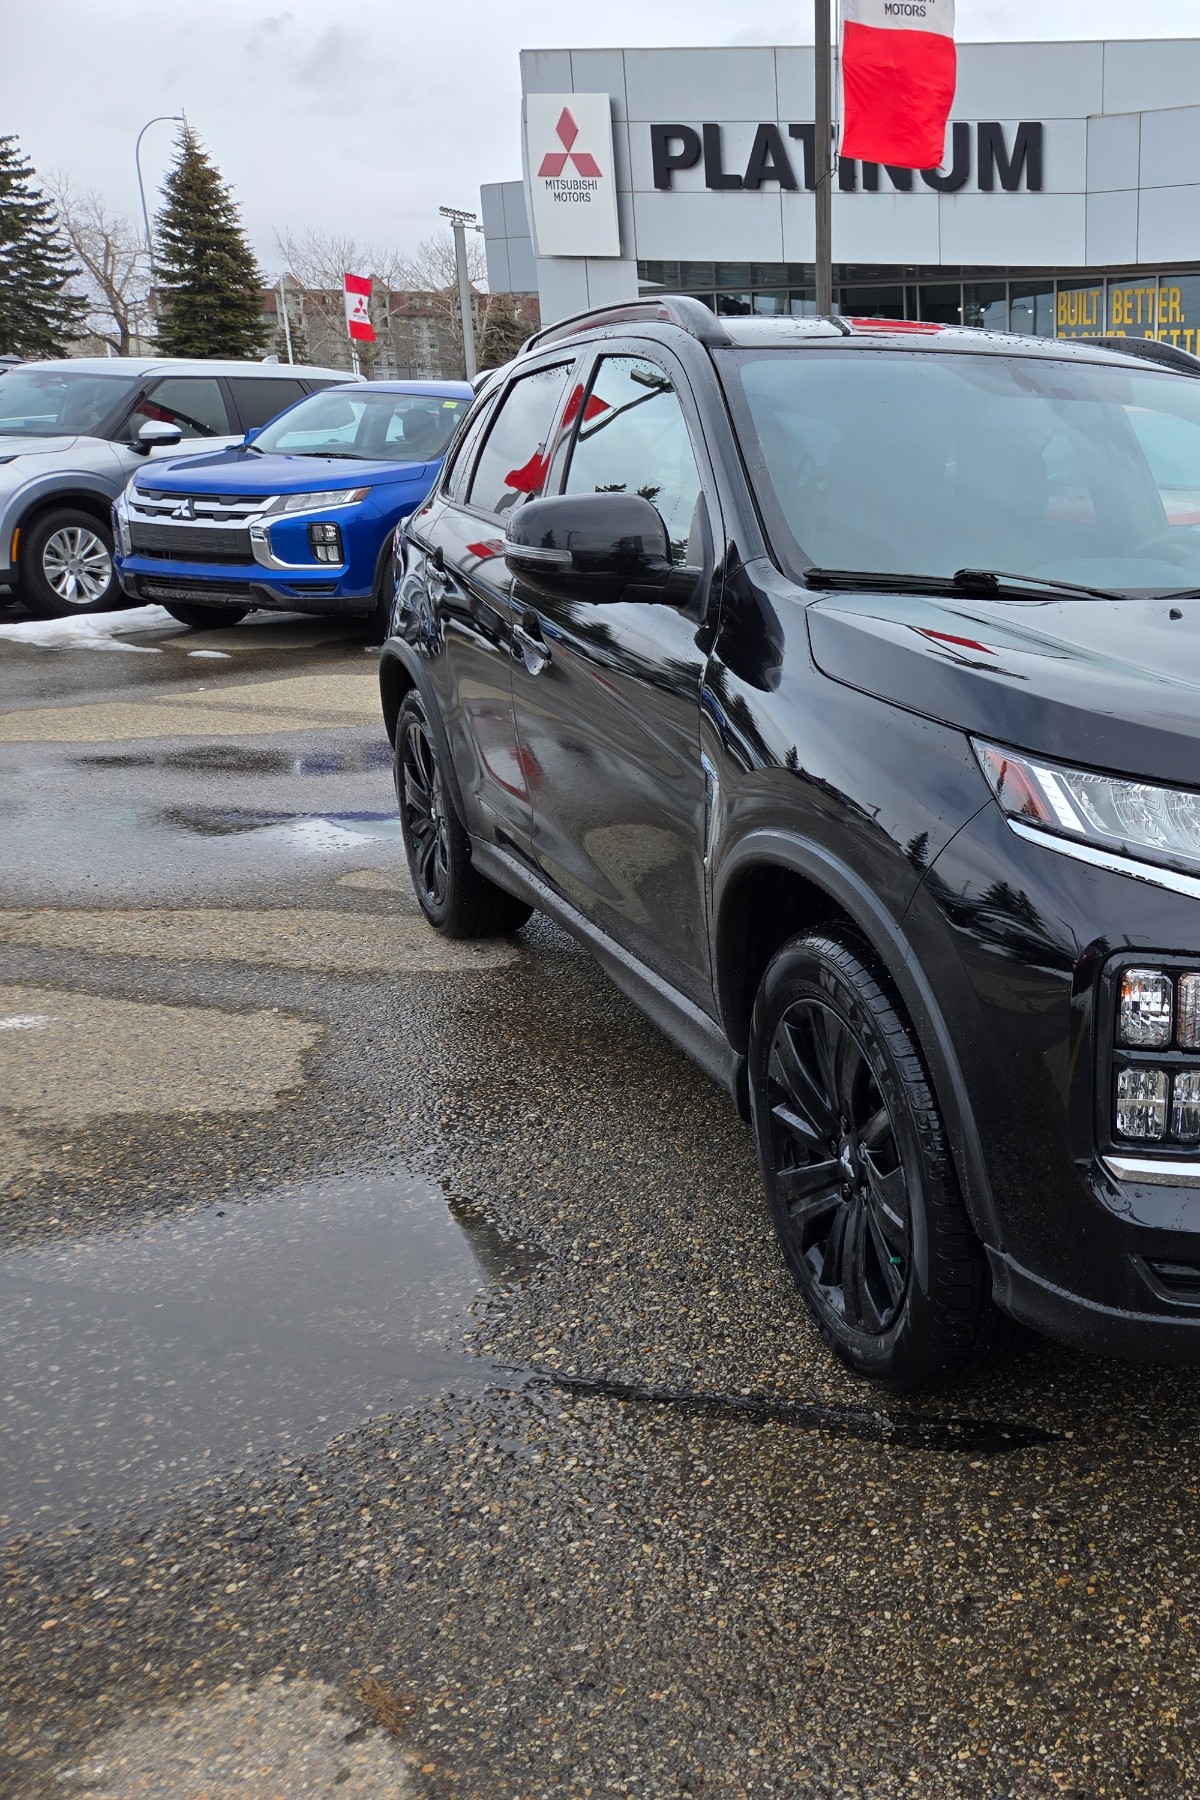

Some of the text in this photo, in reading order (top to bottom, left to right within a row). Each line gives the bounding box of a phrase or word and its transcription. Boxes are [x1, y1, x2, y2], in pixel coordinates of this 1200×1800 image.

[884, 3, 927, 17] MOTORS
[545, 179, 598, 191] MITSUBISHI
[553, 191, 592, 203] MOTORS
[1057, 287, 1185, 326] BUILT BETTER.
